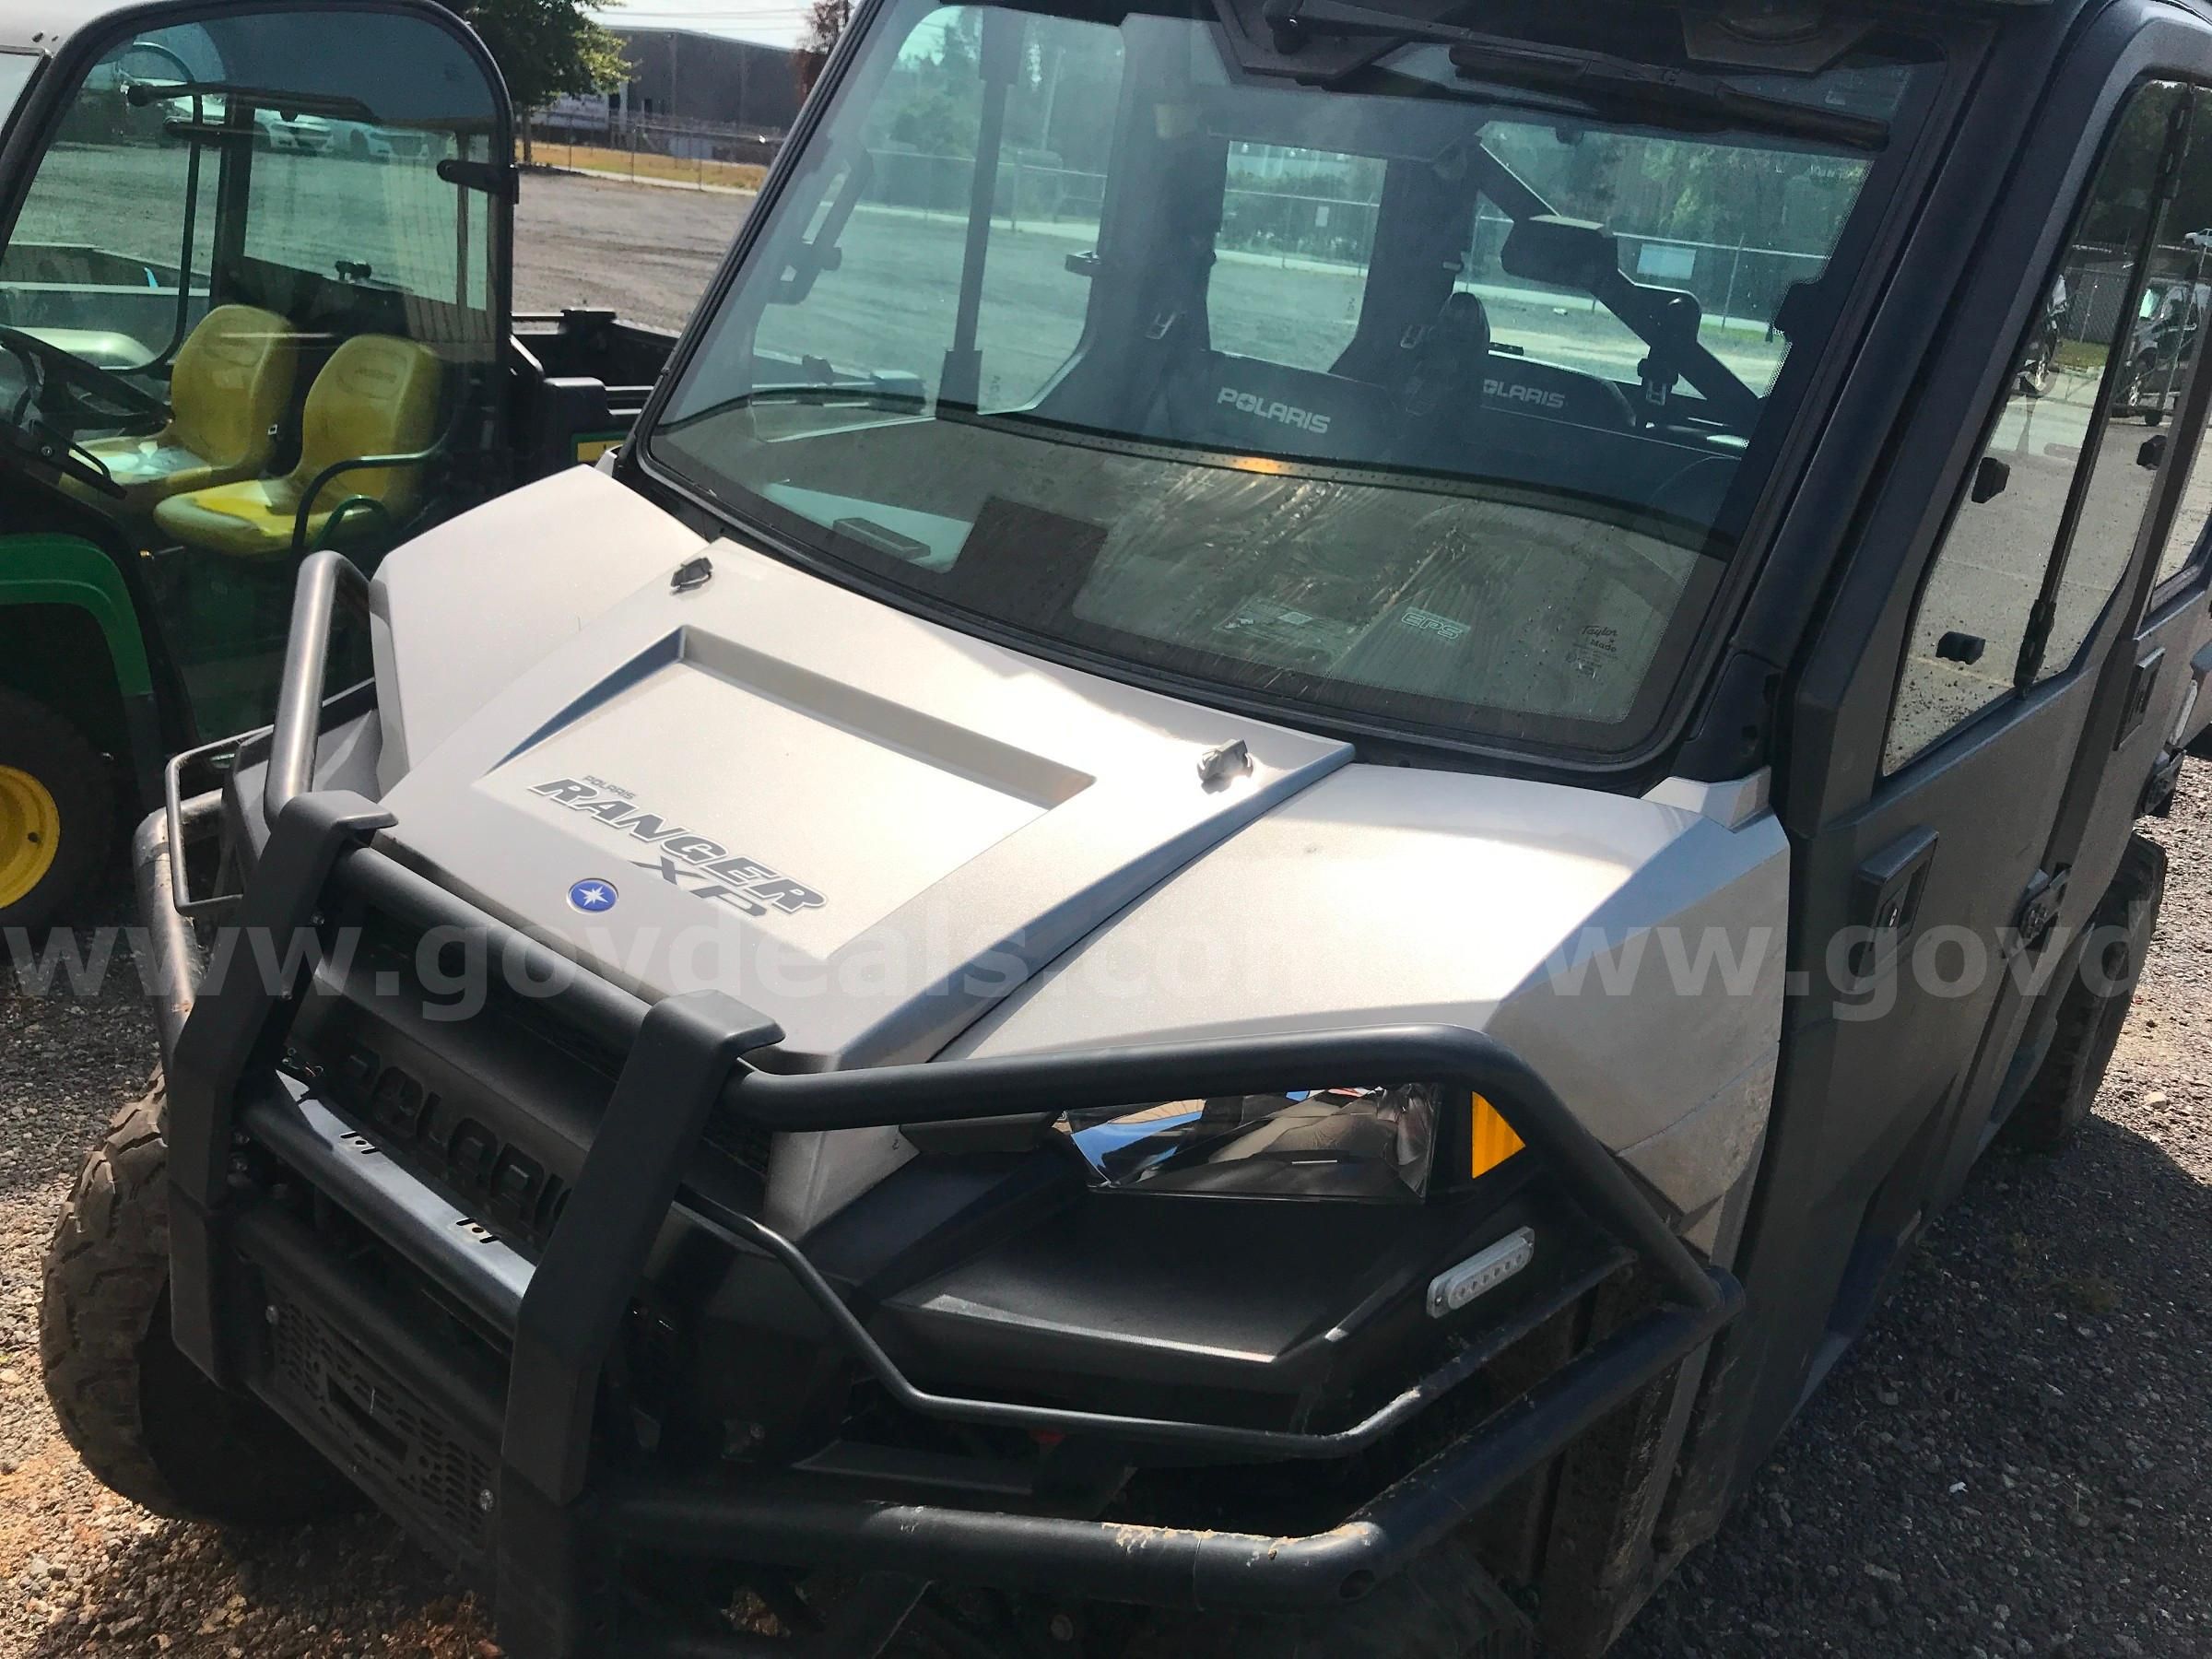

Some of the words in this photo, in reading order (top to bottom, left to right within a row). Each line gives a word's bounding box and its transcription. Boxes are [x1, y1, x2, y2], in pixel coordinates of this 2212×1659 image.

[1217, 387, 1331, 434] POLARIS
[1482, 378, 1565, 408] OLARIS
[1401, 612, 1463, 640] EPS
[1582, 625, 1618, 637] Taylor
[582, 774, 636, 800] POLARIS
[526, 776, 828, 914] RANGER
[629, 855, 768, 917] XP
[335, 1041, 573, 1237] POLARI
